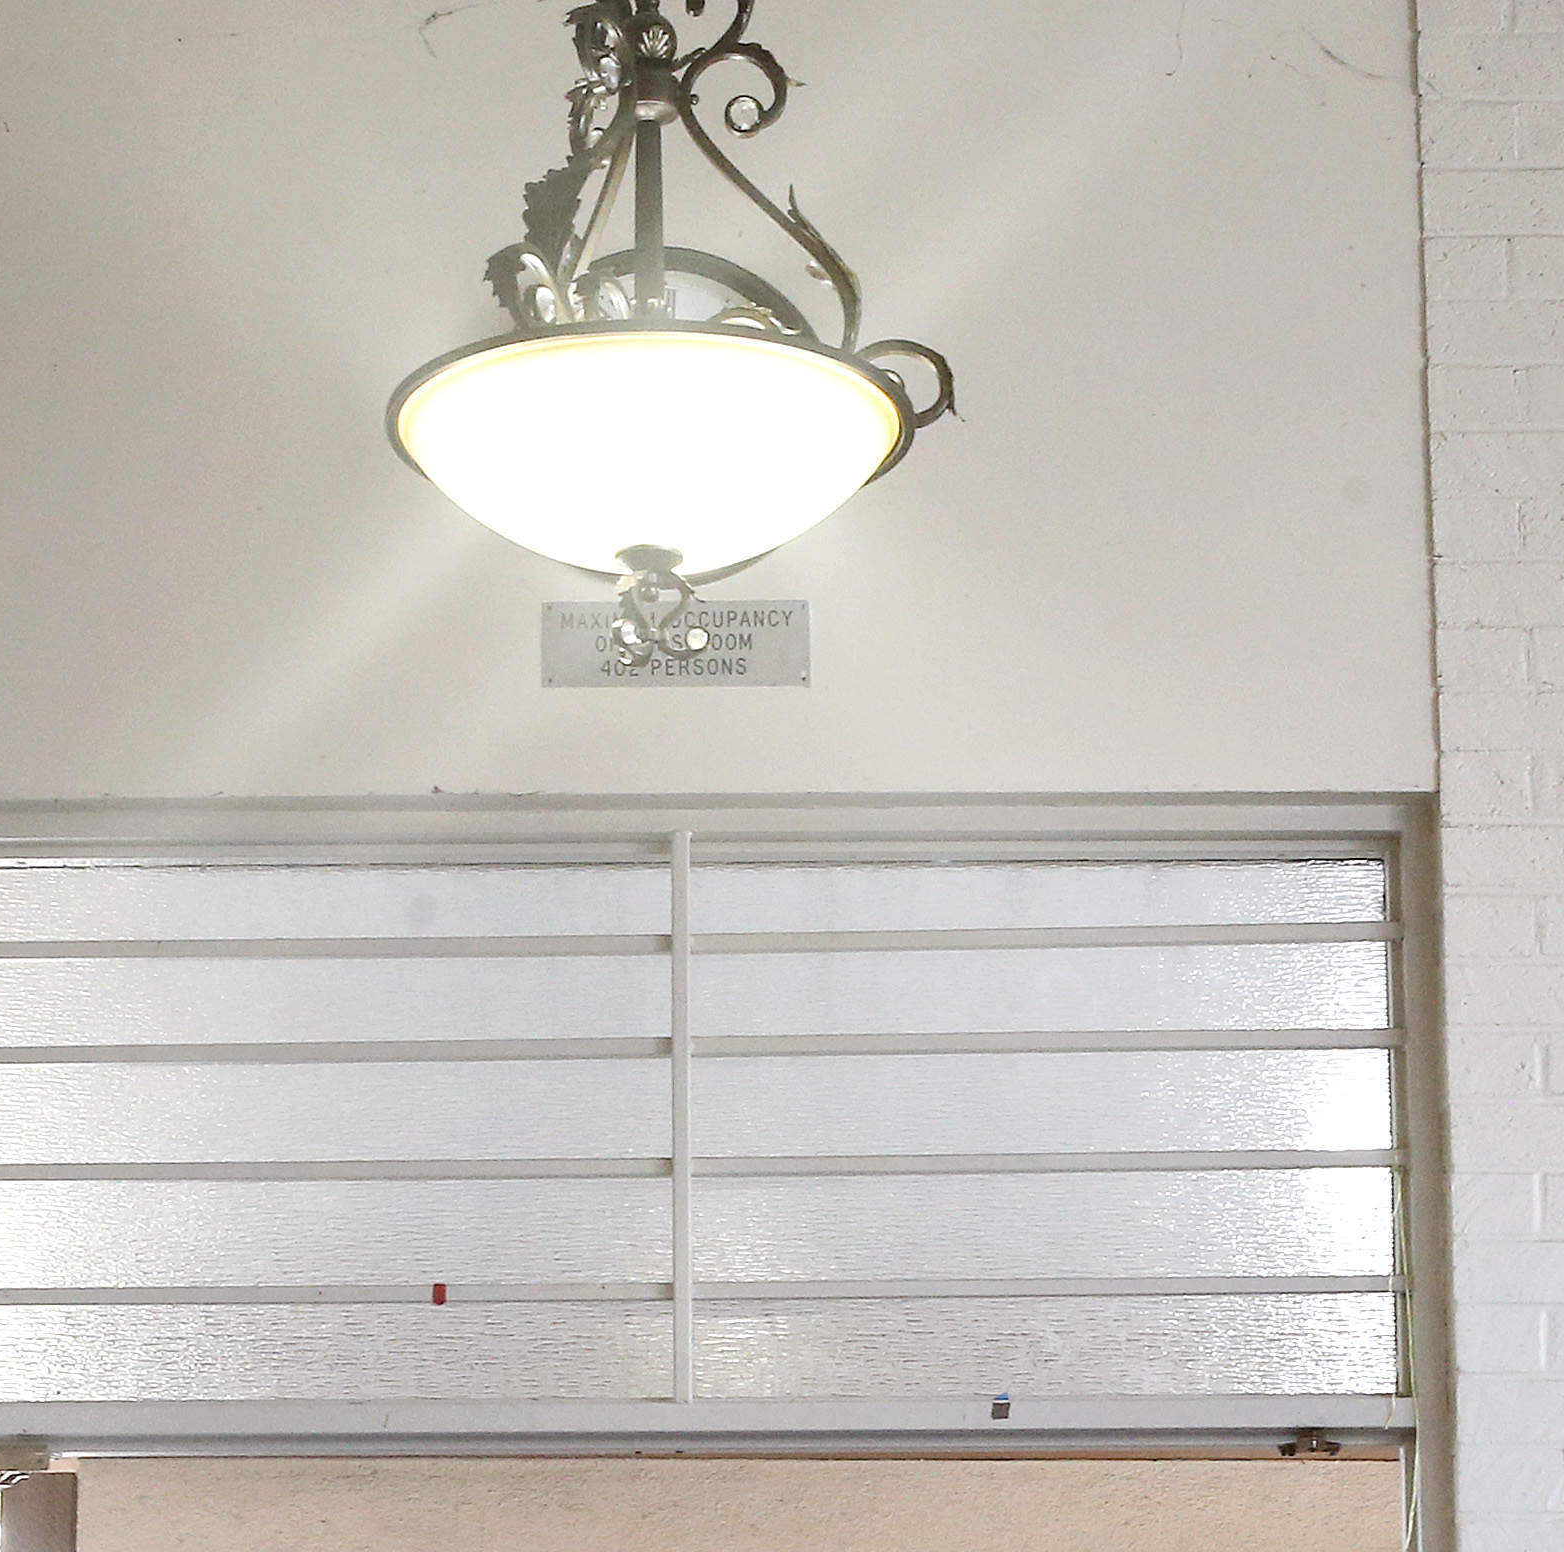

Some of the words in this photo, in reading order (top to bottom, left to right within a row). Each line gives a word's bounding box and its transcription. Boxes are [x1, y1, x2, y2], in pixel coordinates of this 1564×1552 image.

[560, 611, 656, 629] MAXI
[709, 633, 753, 651] OOM
[651, 658, 747, 676] PERSONS
